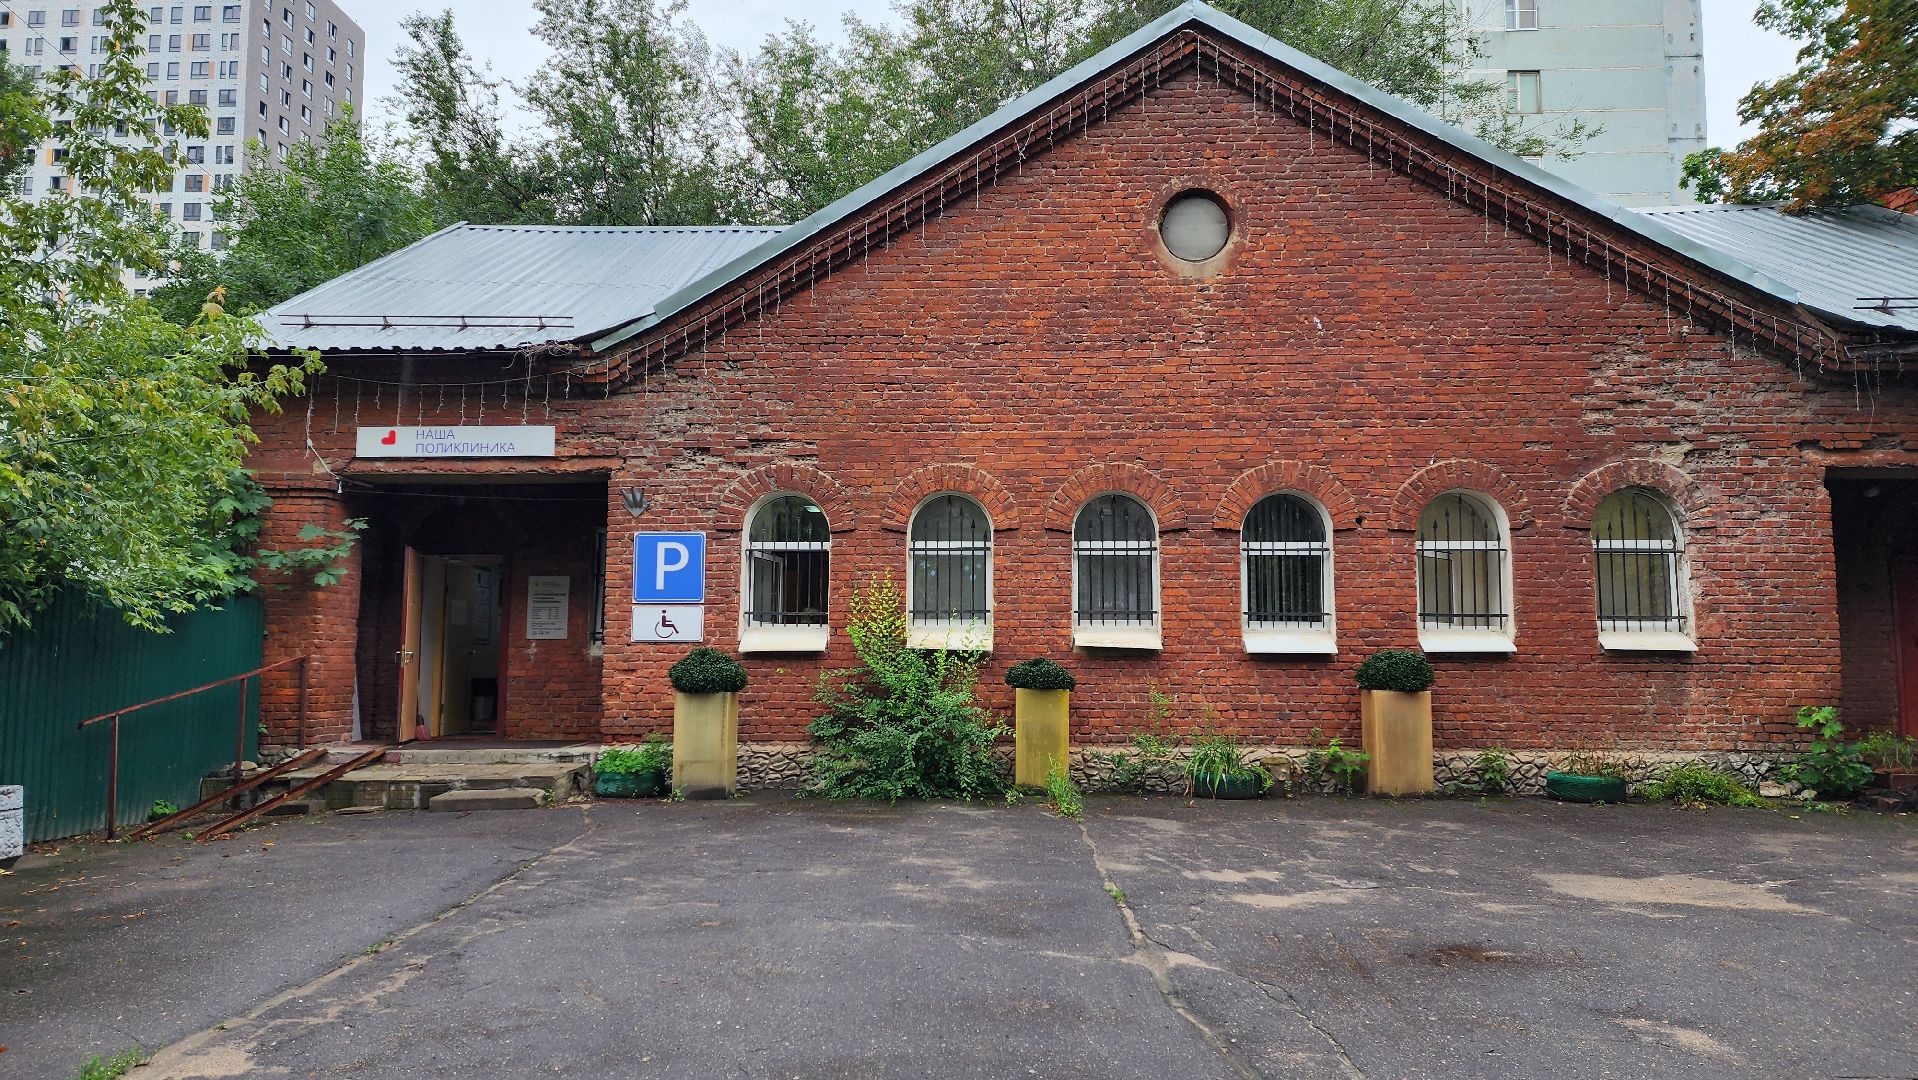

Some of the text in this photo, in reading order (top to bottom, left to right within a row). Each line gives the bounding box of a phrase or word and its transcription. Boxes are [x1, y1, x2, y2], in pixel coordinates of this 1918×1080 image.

[415, 429, 455, 440] НАША
[415, 442, 515, 454] ПОЛИКЛИНИКА
[656, 541, 689, 590] P
